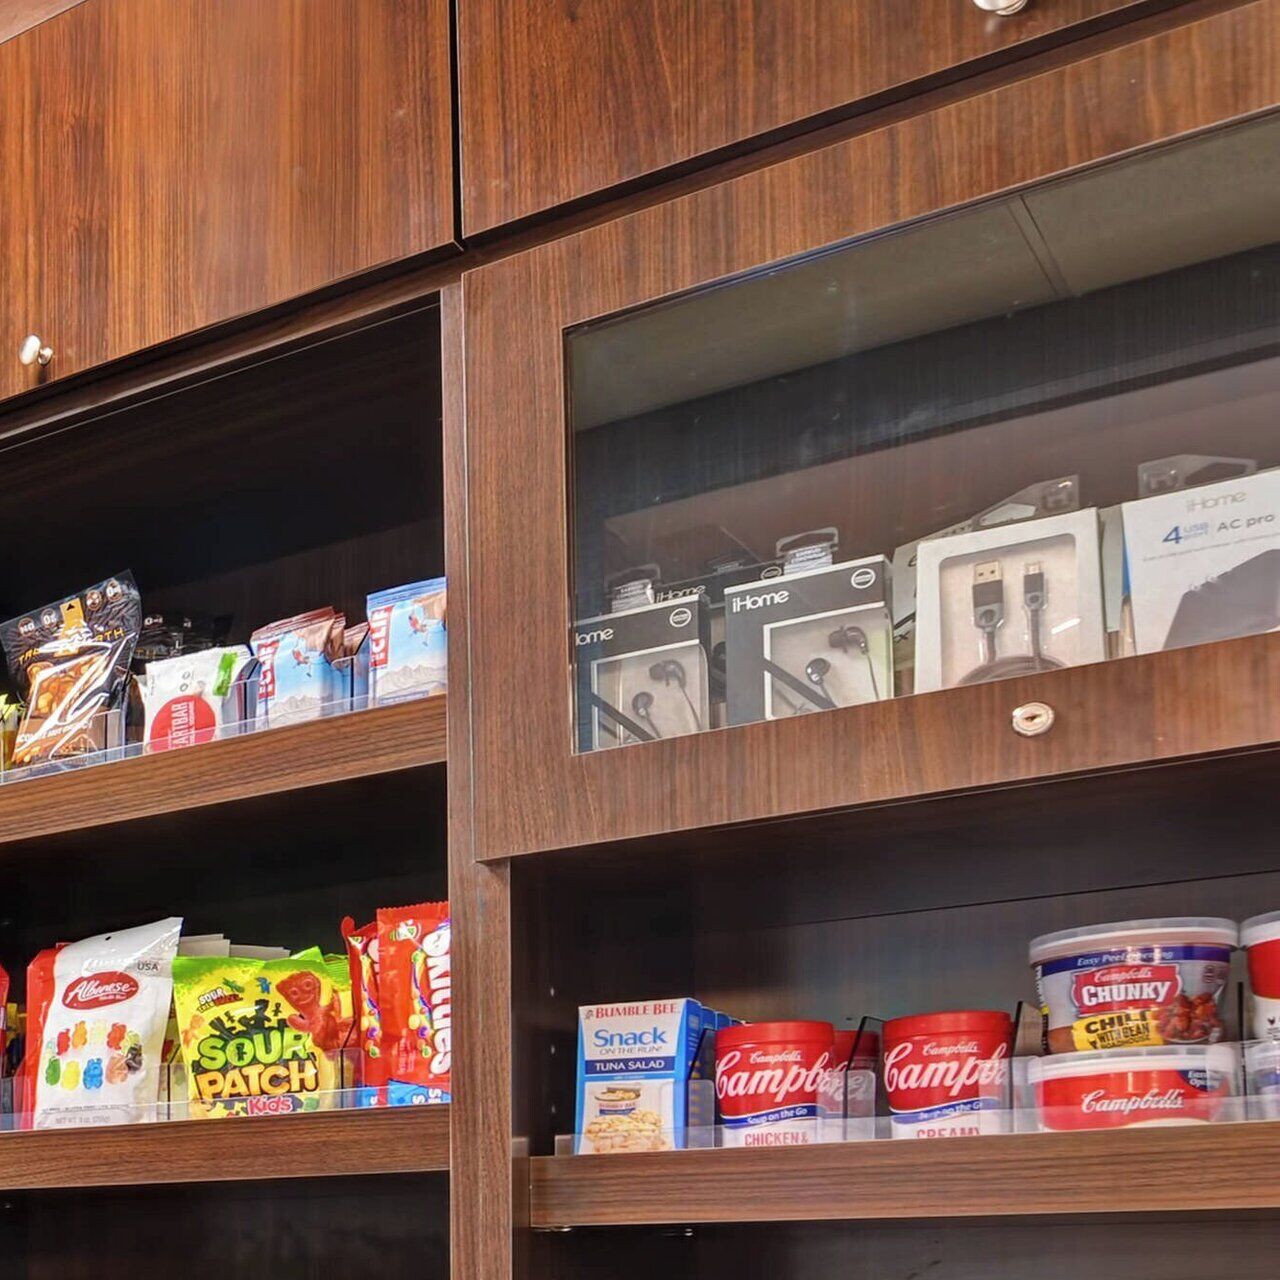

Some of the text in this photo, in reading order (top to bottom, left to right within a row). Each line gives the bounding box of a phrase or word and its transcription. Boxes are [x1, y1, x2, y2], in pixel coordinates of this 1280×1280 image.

[1162, 525, 1183, 544] 4
[1217, 518, 1241, 532] AC
[1246, 513, 1275, 529] pro
[732, 590, 789, 613] iHome
[137, 961, 159, 972] USA
[1077, 953, 1125, 967] Easy Peel
[67, 979, 139, 1003] Albanese
[198, 987, 225, 1005] SOUR
[1081, 980, 1172, 1006] CHUNKY
[595, 1002, 677, 1020] BUMBLE BEE
[593, 1026, 667, 1047] Snack
[198, 1028, 310, 1070] SOUR
[595, 1059, 665, 1072] TUNA SALAD
[195, 1059, 319, 1101] PATCH
[247, 1095, 293, 1116] Kids
[768, 1113, 778, 1122] on
[779, 1110, 795, 1121] the
[796, 1106, 808, 1116] Go
[956, 1103, 973, 1113] the
[744, 1132, 795, 1147] CHICKEN
